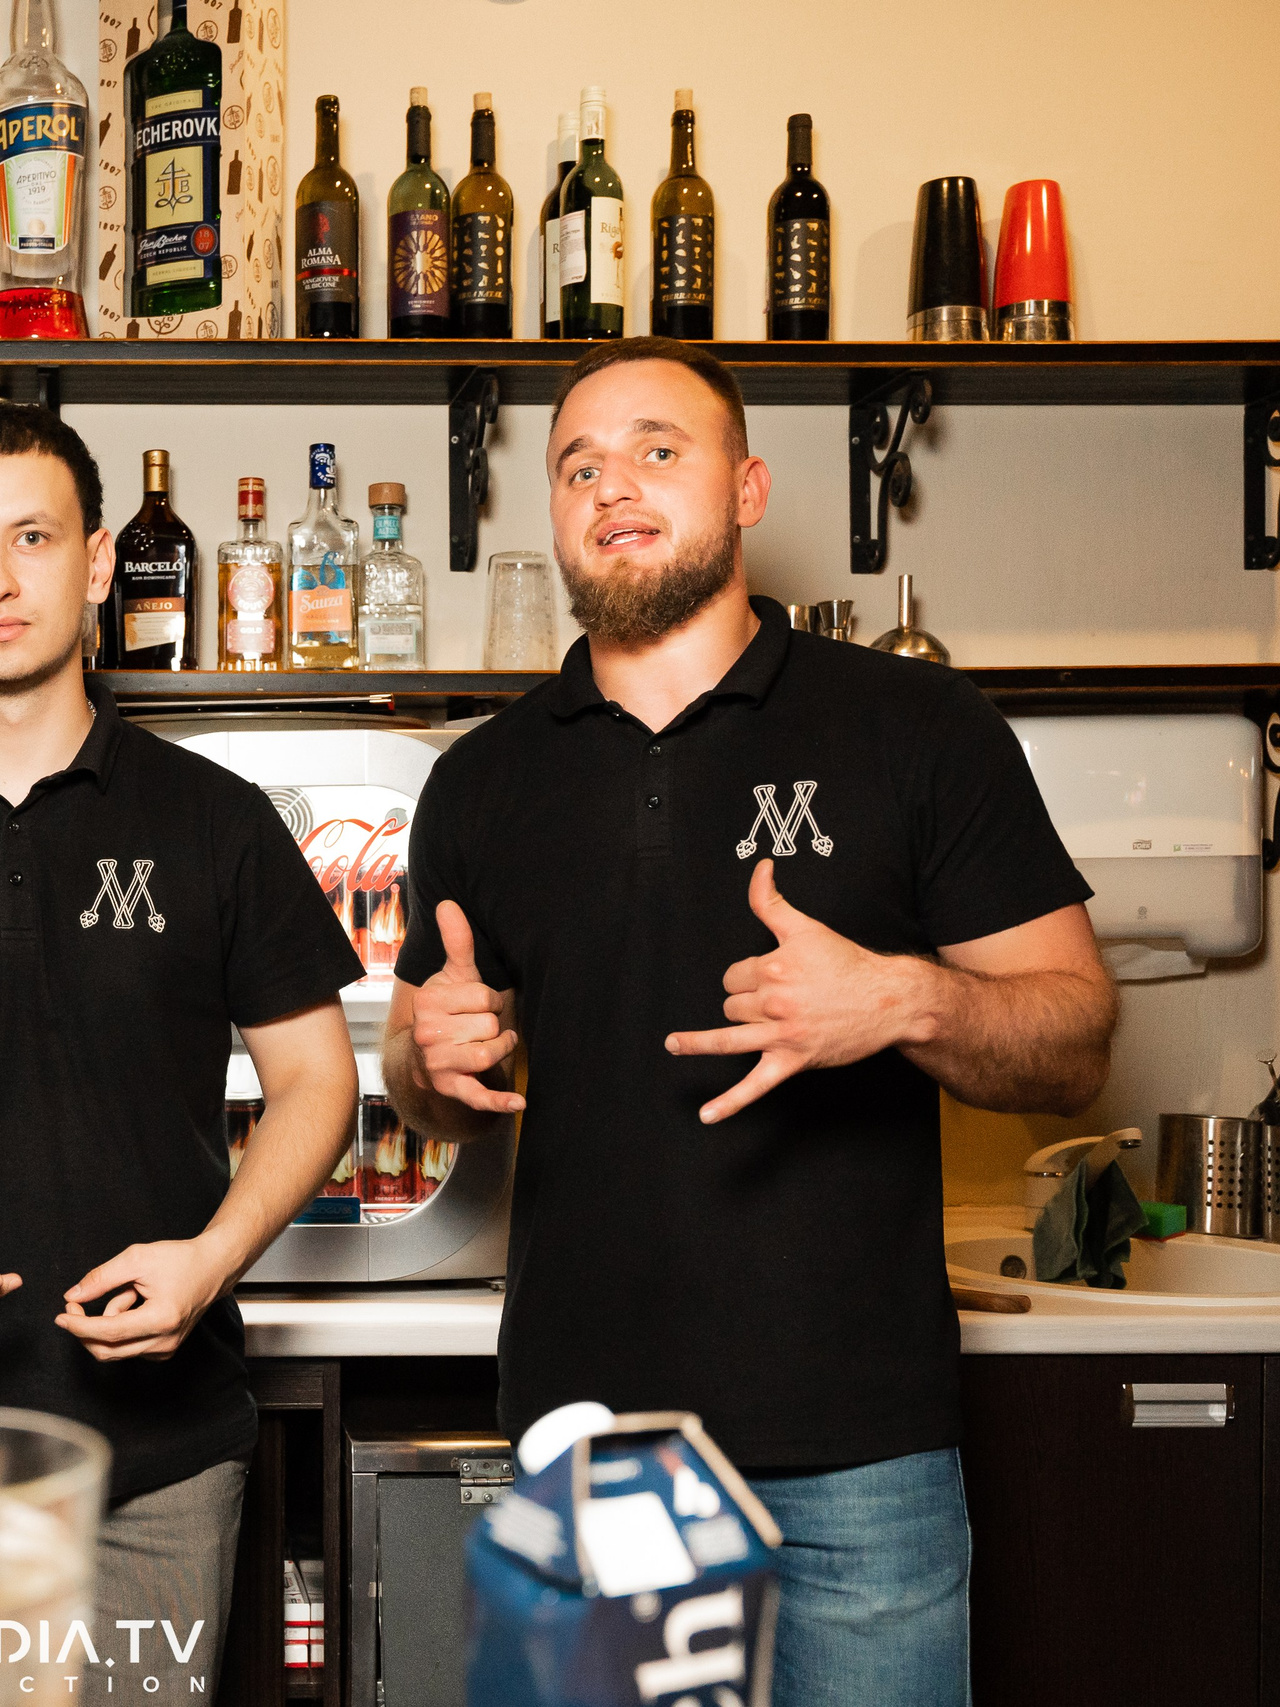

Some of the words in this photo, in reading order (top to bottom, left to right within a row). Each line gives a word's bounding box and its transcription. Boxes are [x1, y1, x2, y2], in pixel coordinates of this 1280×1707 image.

[99, 12, 122, 29] 1807
[99, 79, 118, 88] 807
[135, 117, 220, 150] ECHEROVK
[99, 159, 121, 176] 1807
[16, 170, 57, 185] APERITIVO
[28, 186, 46, 195] 1919
[99, 221, 121, 233] 1807
[158, 245, 187, 255] REPUBLIC
[307, 247, 333, 257] ALMA
[301, 254, 341, 269] ROMANA
[99, 305, 121, 323] 1807
[125, 558, 183, 574] BARCELÓ
[135, 600, 173, 611] AÑEJO
[300, 594, 344, 614] Sauza
